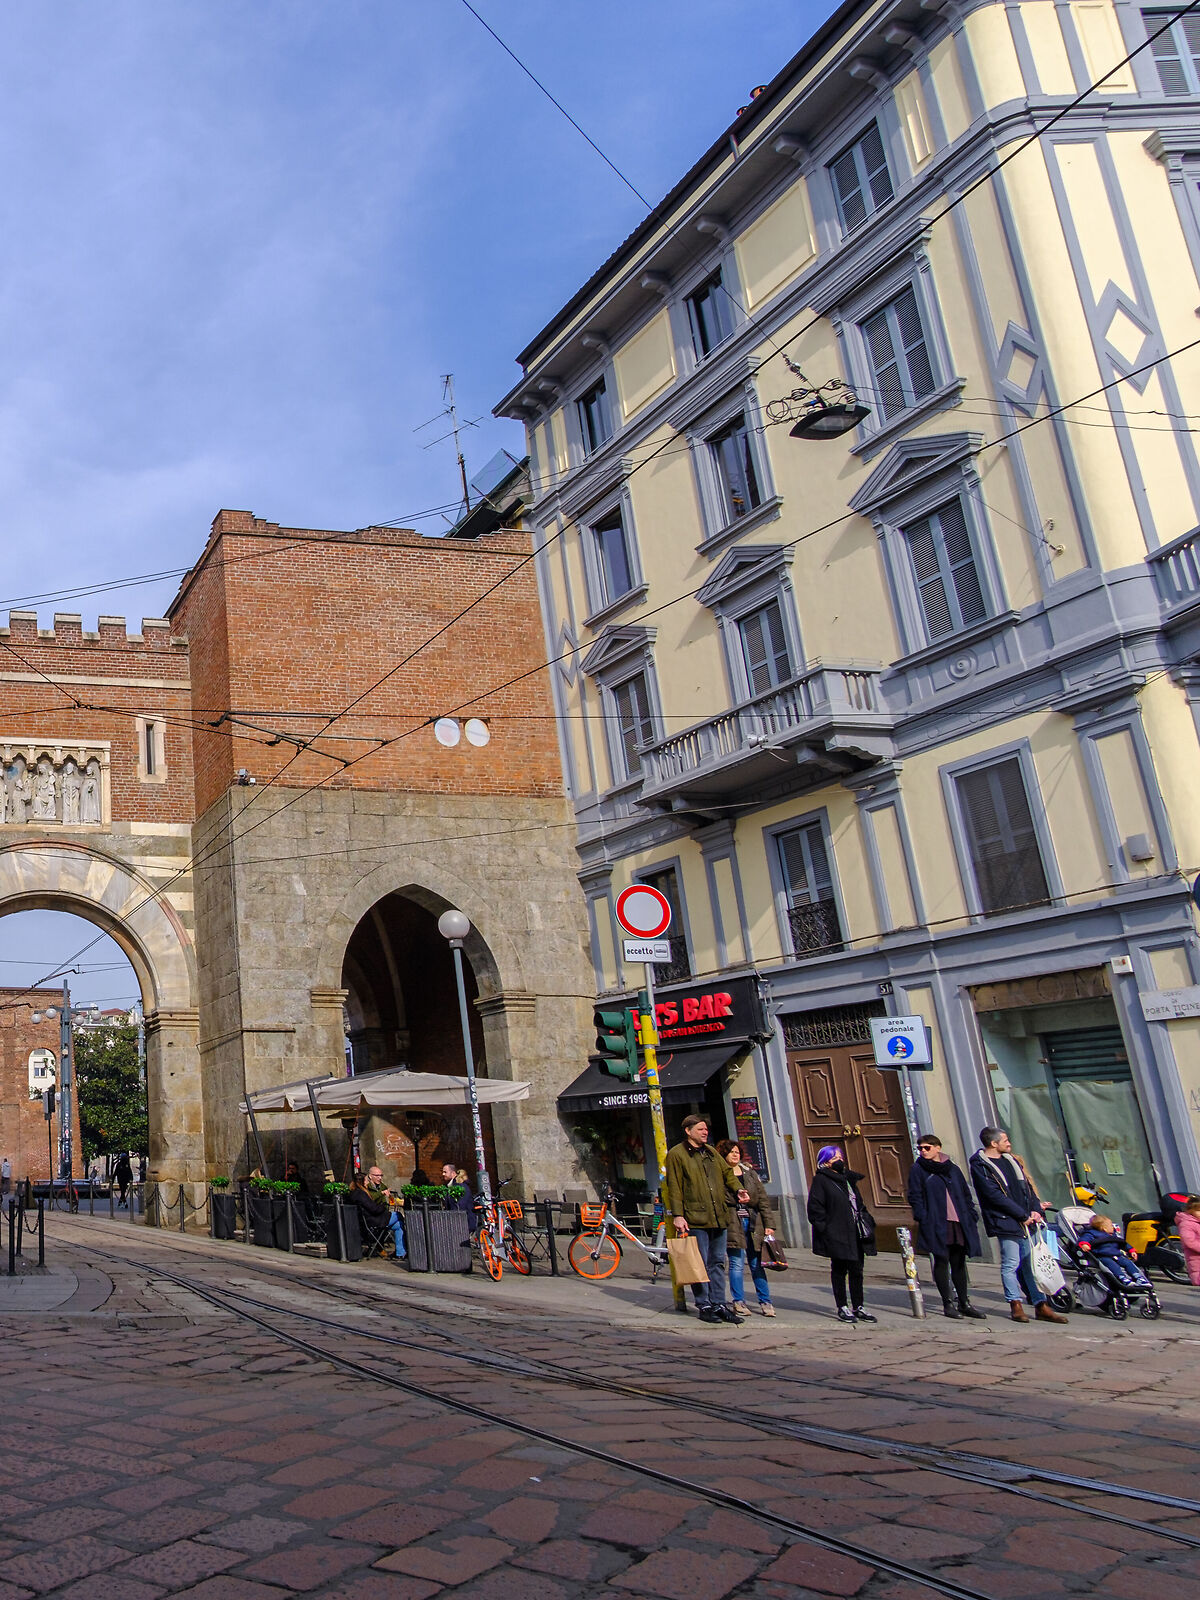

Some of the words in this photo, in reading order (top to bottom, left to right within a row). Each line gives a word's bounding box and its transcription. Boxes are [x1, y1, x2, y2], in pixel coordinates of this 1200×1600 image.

[626, 947, 654, 955] eccetto
[682, 992, 734, 1022] BAR
[1145, 1006, 1171, 1015] PORTA
[880, 1026, 915, 1034] pedonale
[603, 1094, 628, 1106] SINCE
[629, 1093, 648, 1104] 1992
